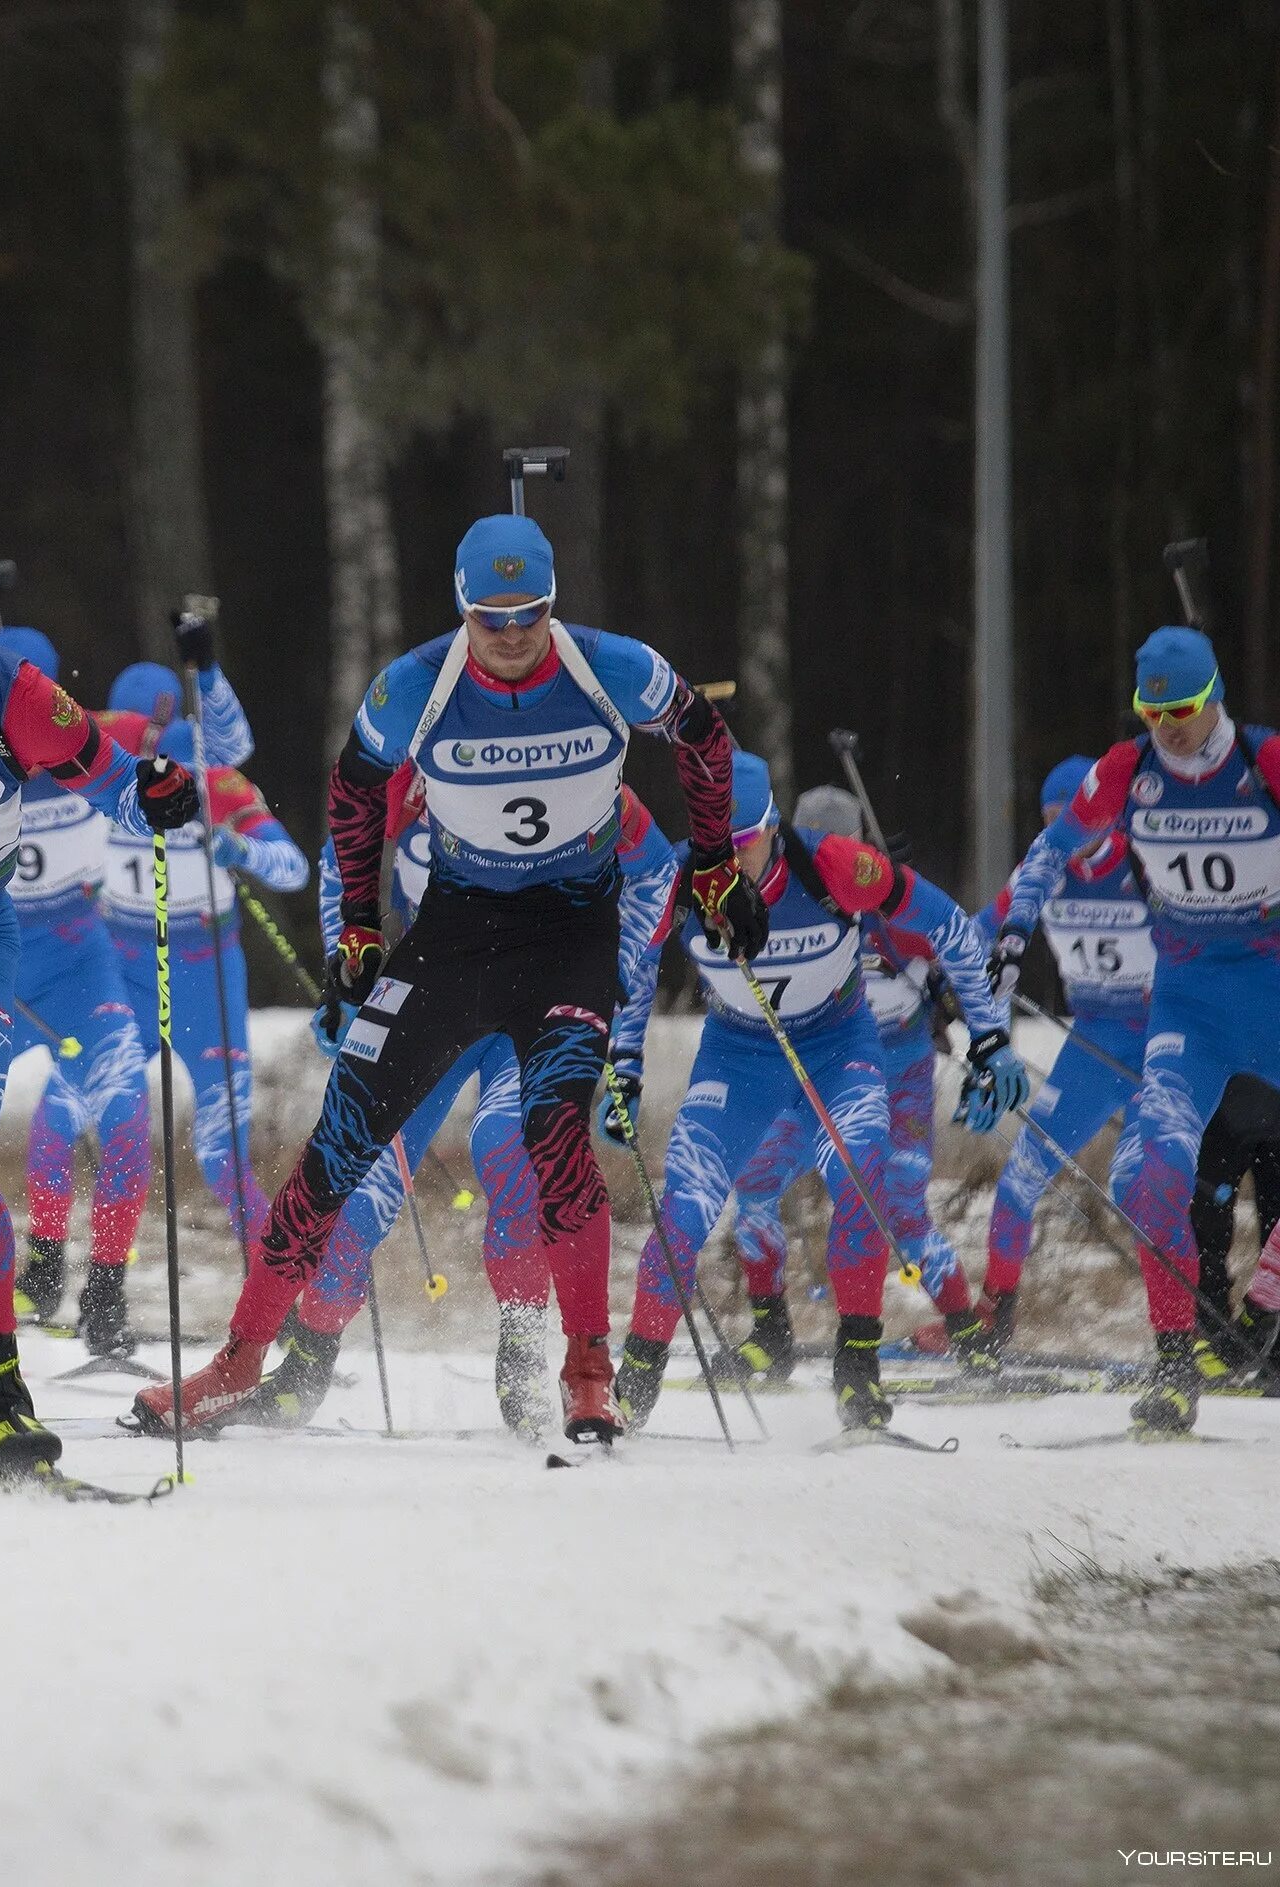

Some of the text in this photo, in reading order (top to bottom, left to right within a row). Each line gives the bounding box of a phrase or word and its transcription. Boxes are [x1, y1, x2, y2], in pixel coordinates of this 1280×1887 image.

[419, 699, 441, 736] LARSEN
[592, 688, 620, 724] LARSEN
[480, 736, 595, 768] Фортум
[502, 796, 551, 847] 3
[1164, 812, 1254, 840] Фортум
[17, 842, 47, 882] 9
[463, 842, 588, 871] ТЮМЕНСКАЯ ОБЛАСТЬ
[1167, 851, 1237, 893] 10
[767, 930, 827, 955] ртум
[1071, 936, 1124, 975] 15
[754, 973, 793, 1011] 7
